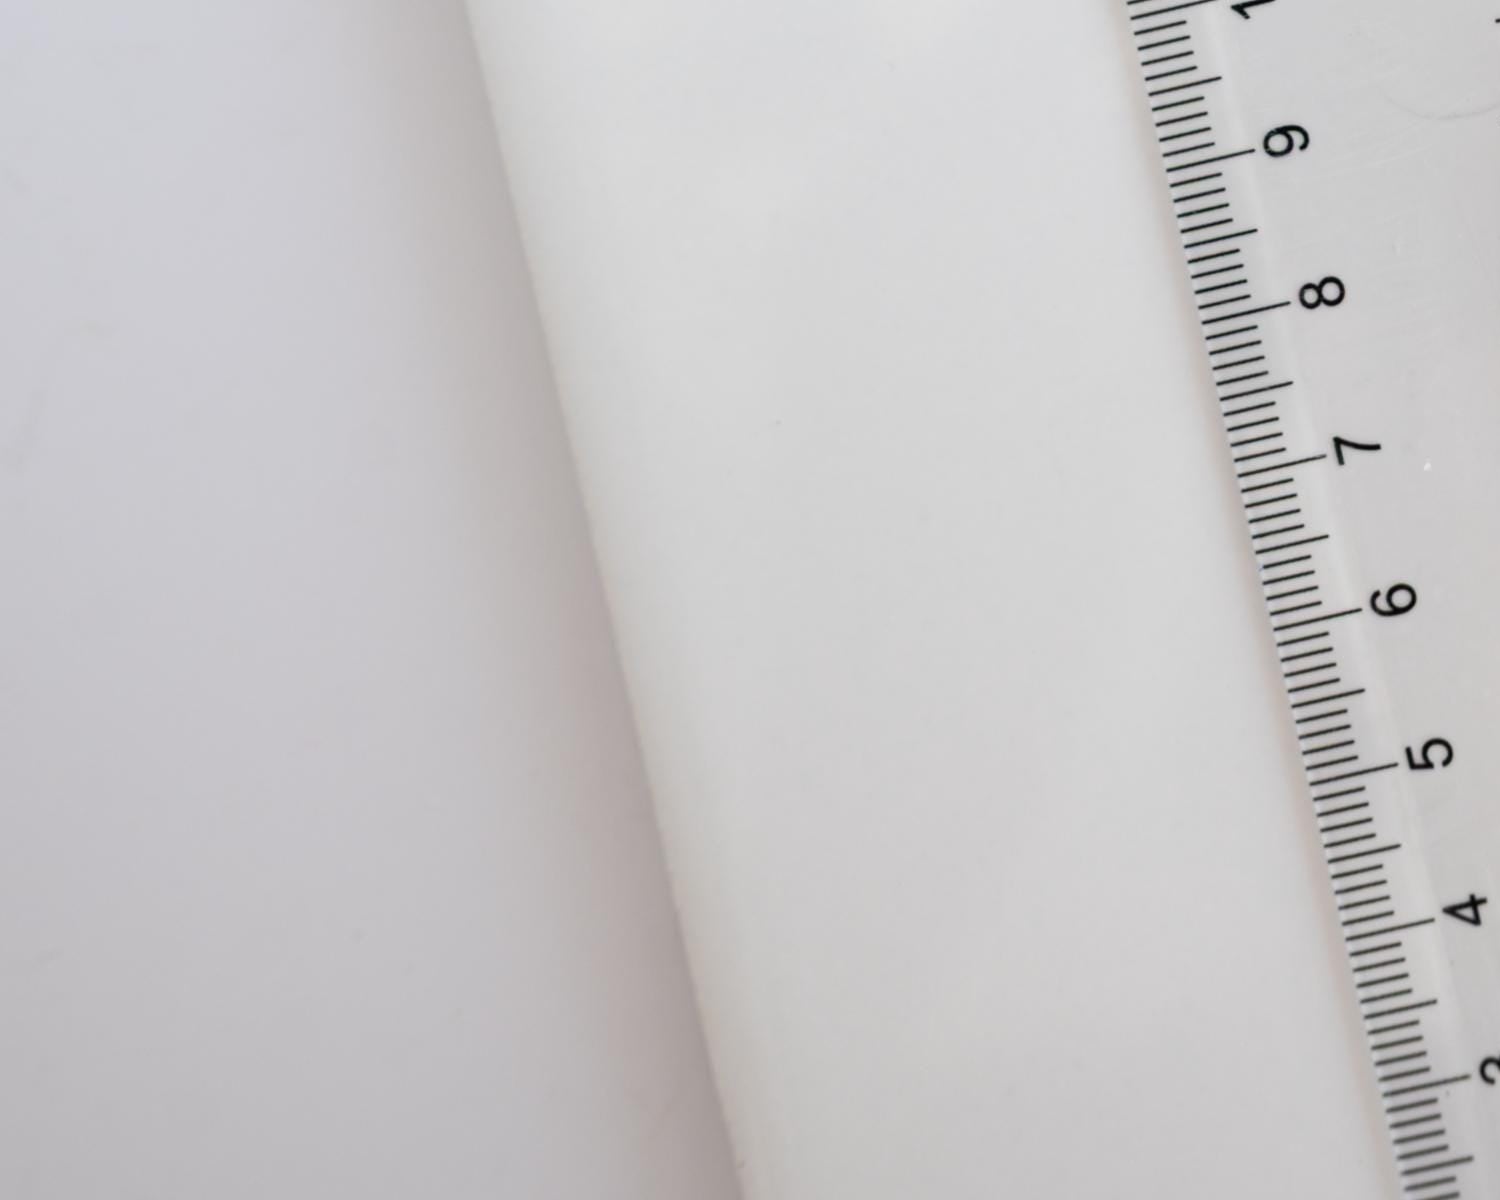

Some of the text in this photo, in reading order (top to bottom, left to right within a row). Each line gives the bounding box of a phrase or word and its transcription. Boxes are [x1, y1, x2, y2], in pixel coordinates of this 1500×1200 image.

[1261, 123, 1311, 159] 9
[1297, 275, 1347, 311] 8
[1331, 435, 1383, 467] 7
[1368, 582, 1418, 618] 6
[1404, 736, 1455, 772] 5
[1441, 892, 1489, 928] 4
